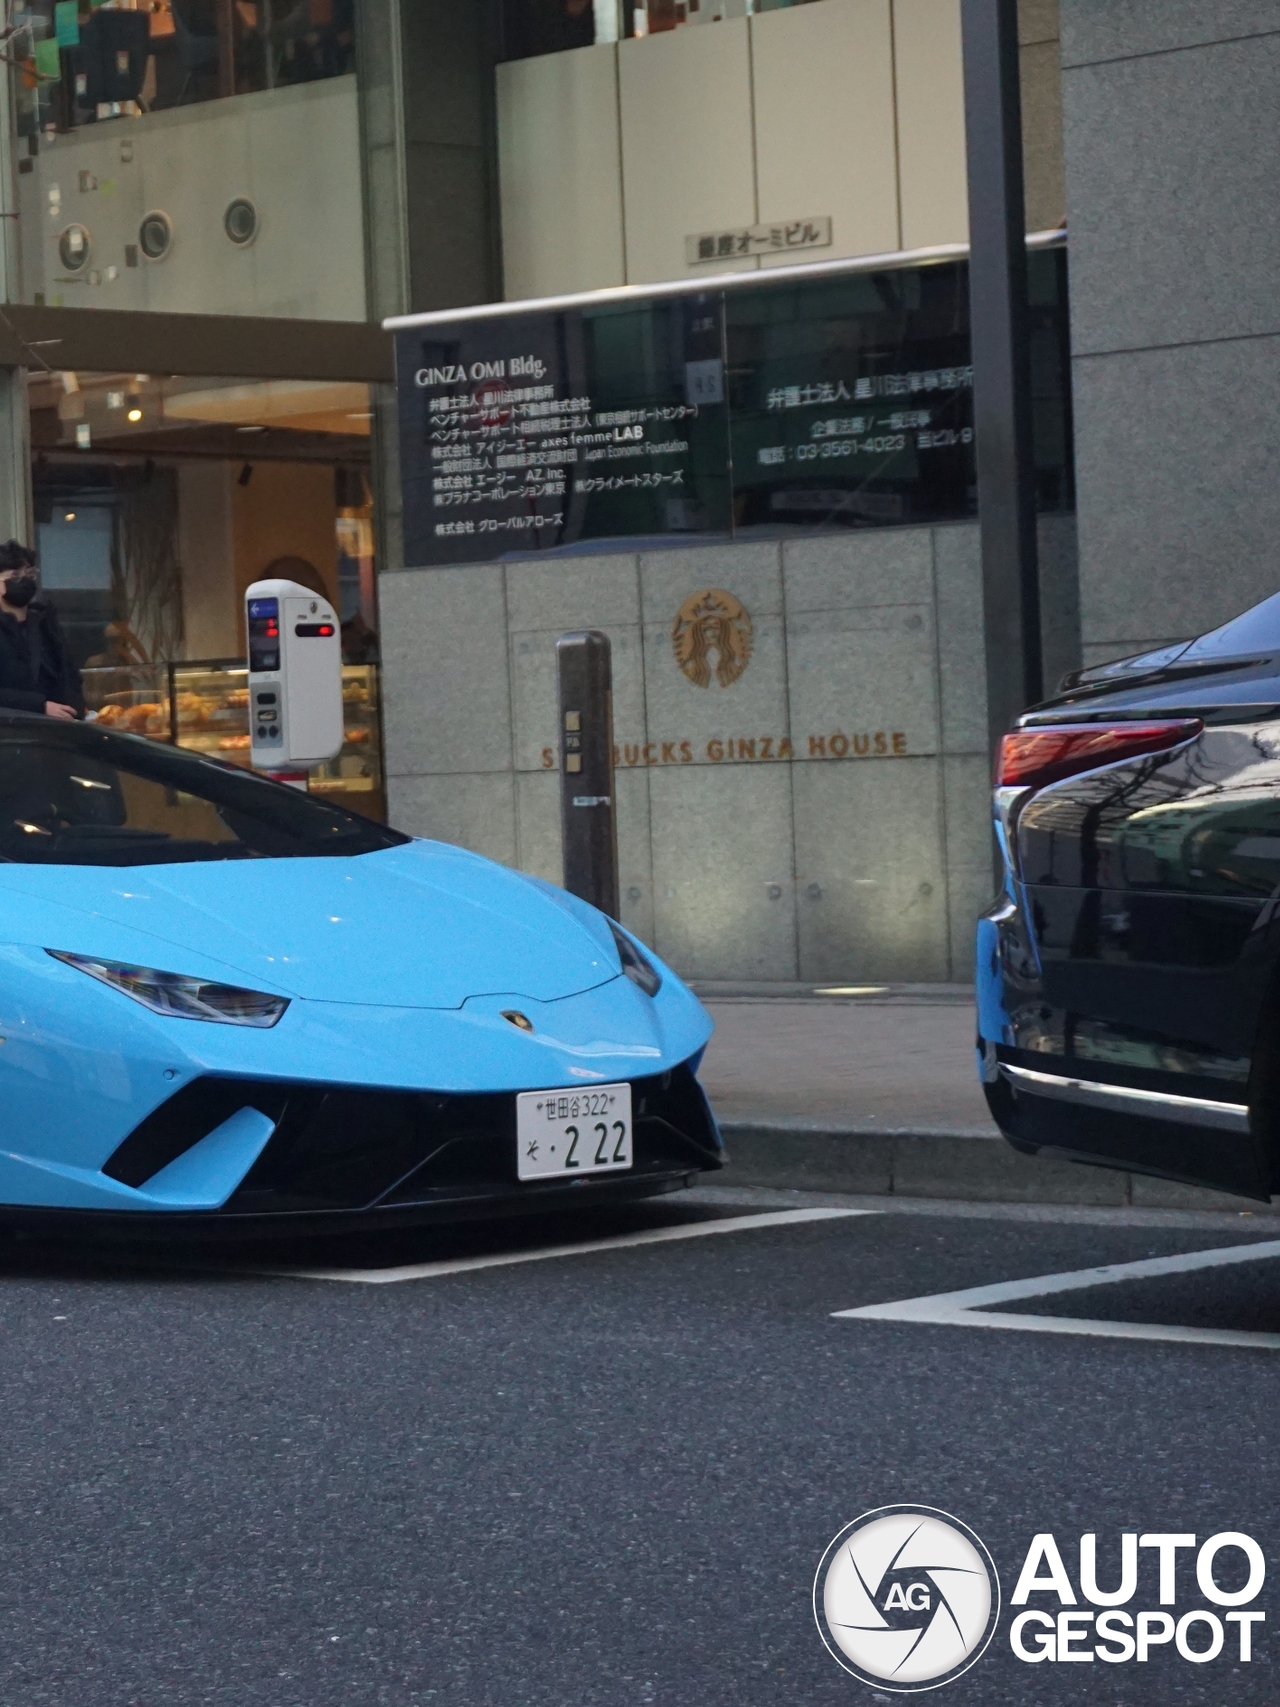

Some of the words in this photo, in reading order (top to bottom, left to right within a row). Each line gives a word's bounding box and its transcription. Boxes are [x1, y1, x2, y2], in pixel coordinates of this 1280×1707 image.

[415, 365, 467, 387] GINZA
[471, 360, 505, 380] OMI
[510, 355, 547, 379] Bldg.
[431, 443, 472, 459] 株式会社
[476, 437, 537, 455] アイジーエー
[541, 436, 568, 449] axes
[432, 475, 473, 490] 株式会社
[476, 471, 517, 486] エージー
[434, 519, 475, 537] 株式会社
[478, 512, 563, 533] グローバルアローズ
[706, 737, 794, 762] GINZA
[807, 731, 907, 757] HOUSE
